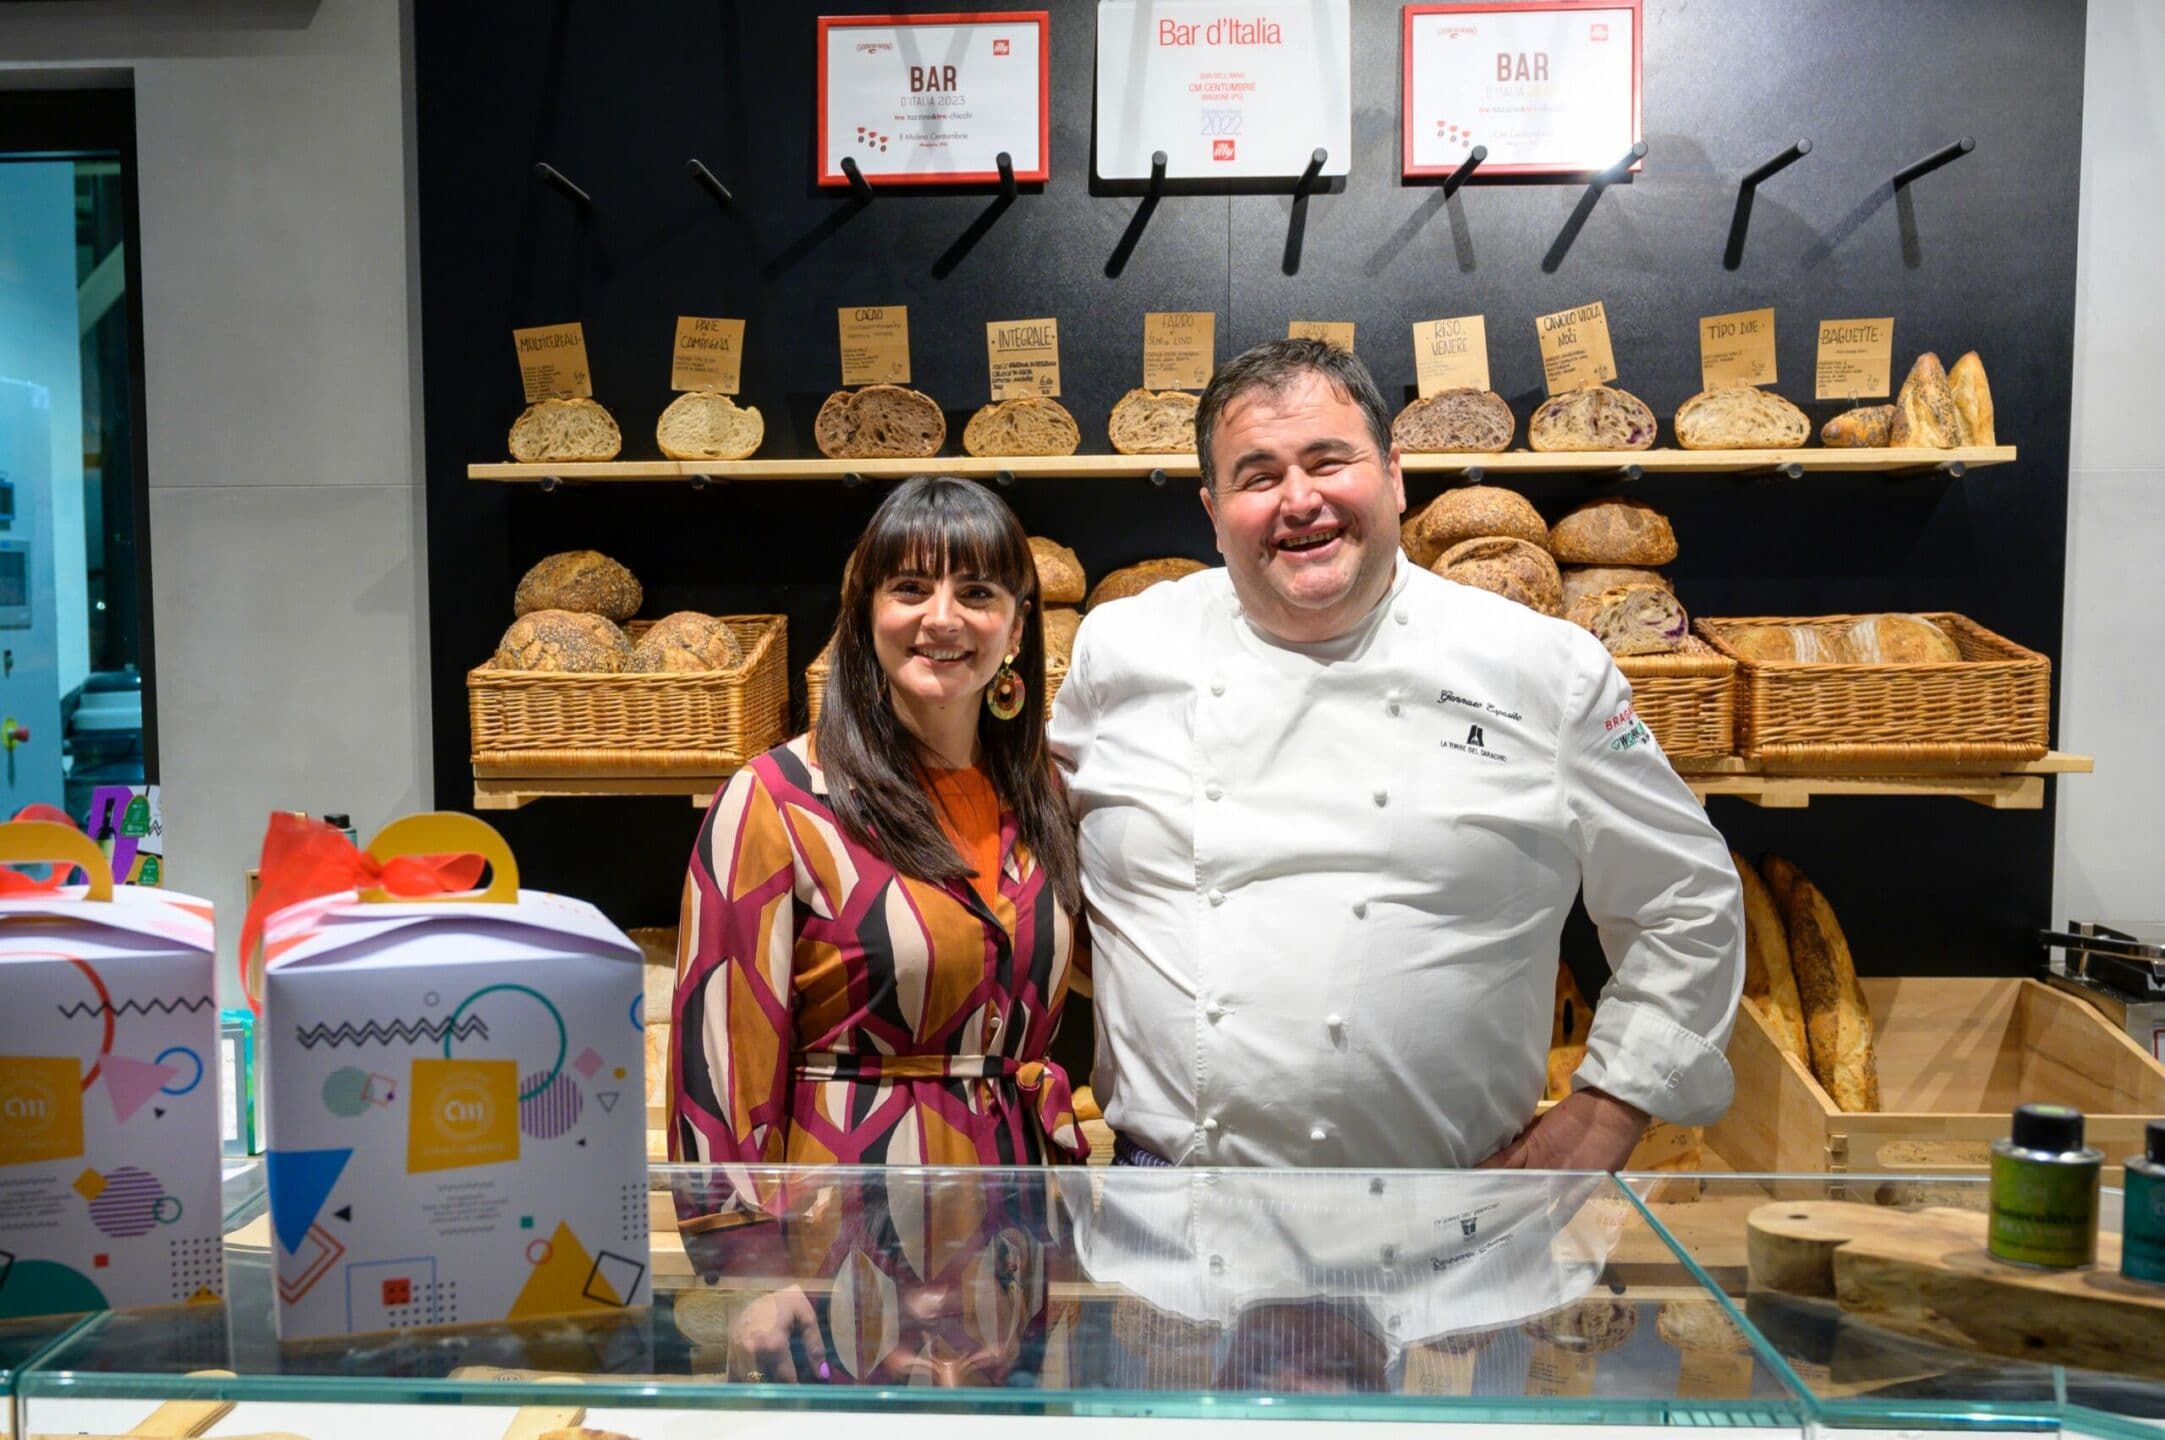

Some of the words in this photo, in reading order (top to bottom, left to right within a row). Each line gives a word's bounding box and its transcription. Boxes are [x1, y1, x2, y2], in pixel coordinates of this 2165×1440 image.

[1159, 19, 1200, 46] Bar
[1206, 17, 1282, 45] d'Italia
[1496, 52, 1550, 82] BAR
[910, 65, 957, 93] BAR
[938, 95, 966, 106] 2023
[1213, 141, 1234, 160] illy
[855, 308, 884, 322] CACAO
[998, 326, 1052, 348] INTEGRALE
[1434, 320, 1461, 339] RISO
[1821, 325, 1879, 345] BAGUETTE
